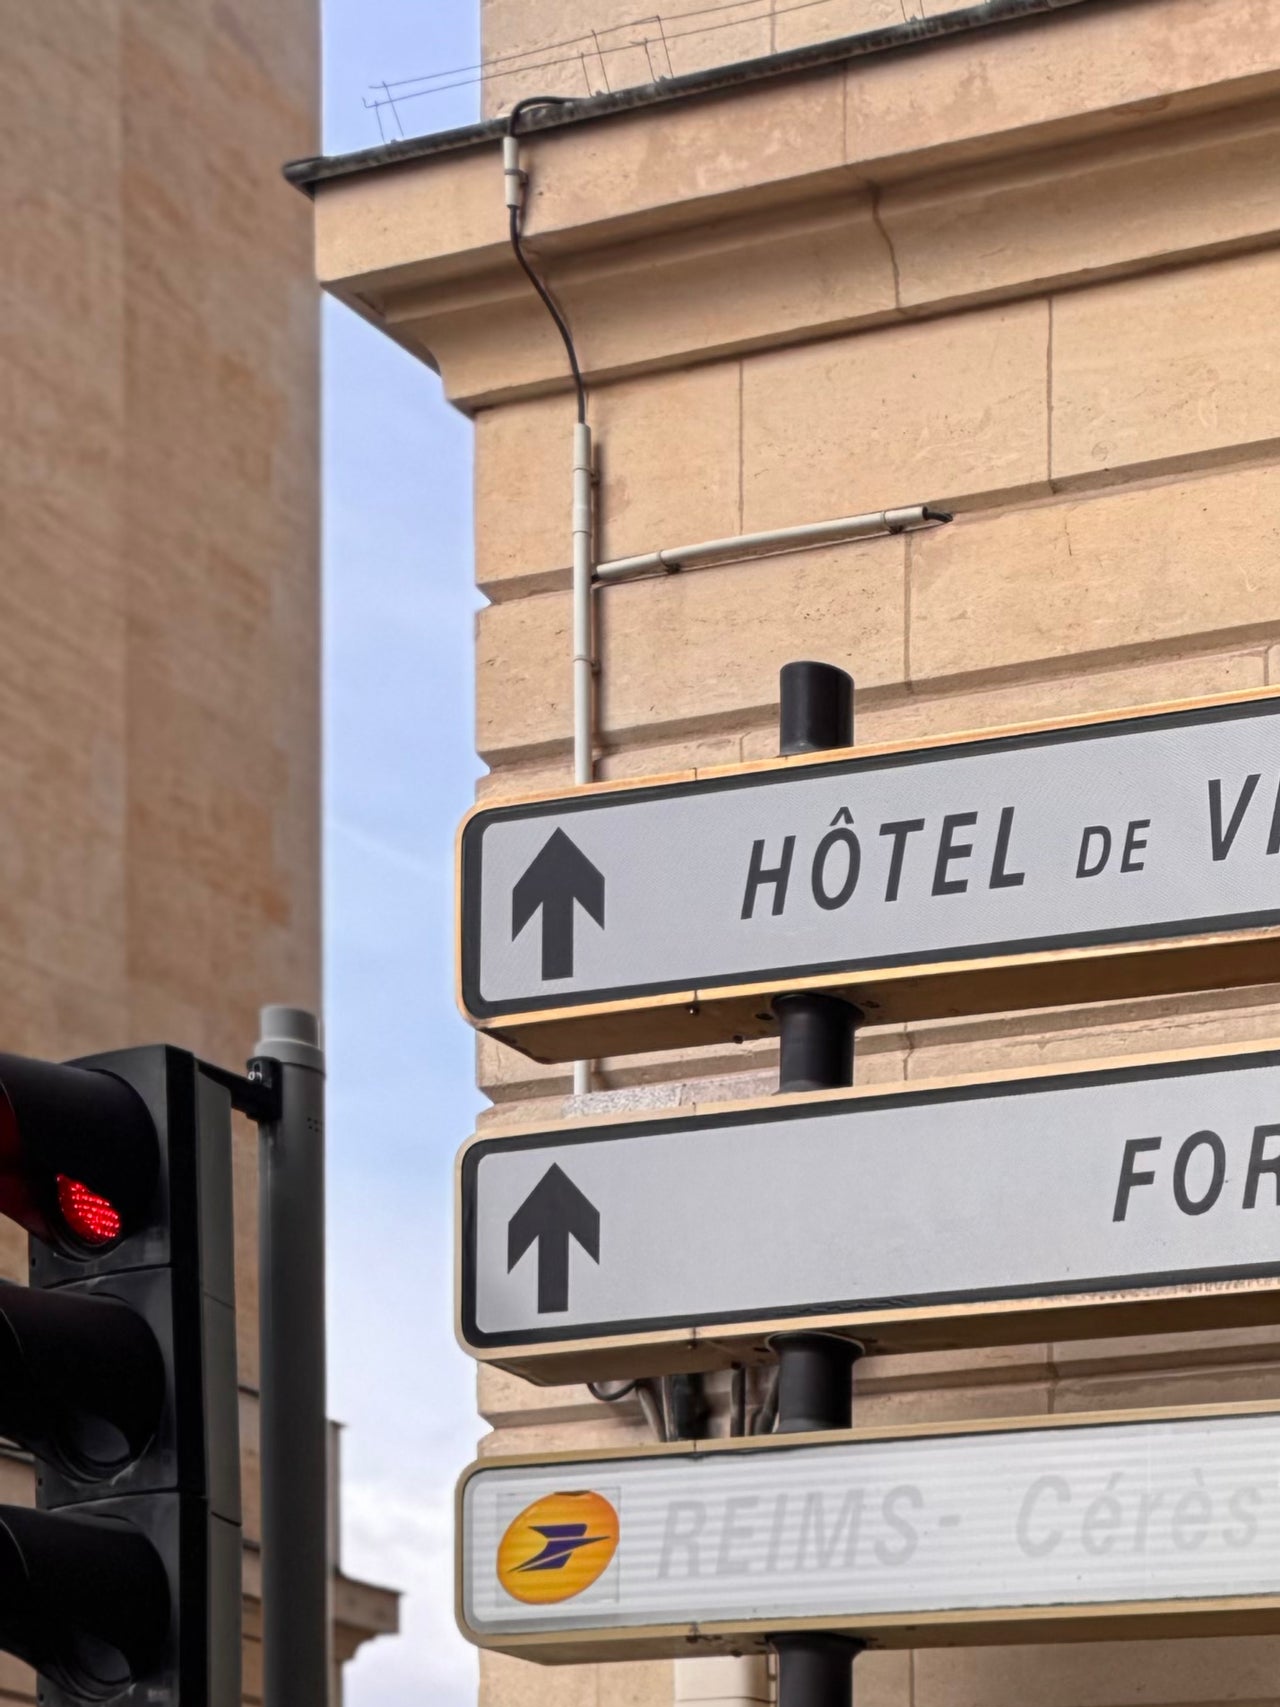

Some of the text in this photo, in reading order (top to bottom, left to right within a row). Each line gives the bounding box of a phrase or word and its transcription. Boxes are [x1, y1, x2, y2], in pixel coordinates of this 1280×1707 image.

[739, 805, 1027, 920] HÔTEL
[1074, 818, 1152, 880] DE
[1015, 1466, 1264, 1558] Cérès
